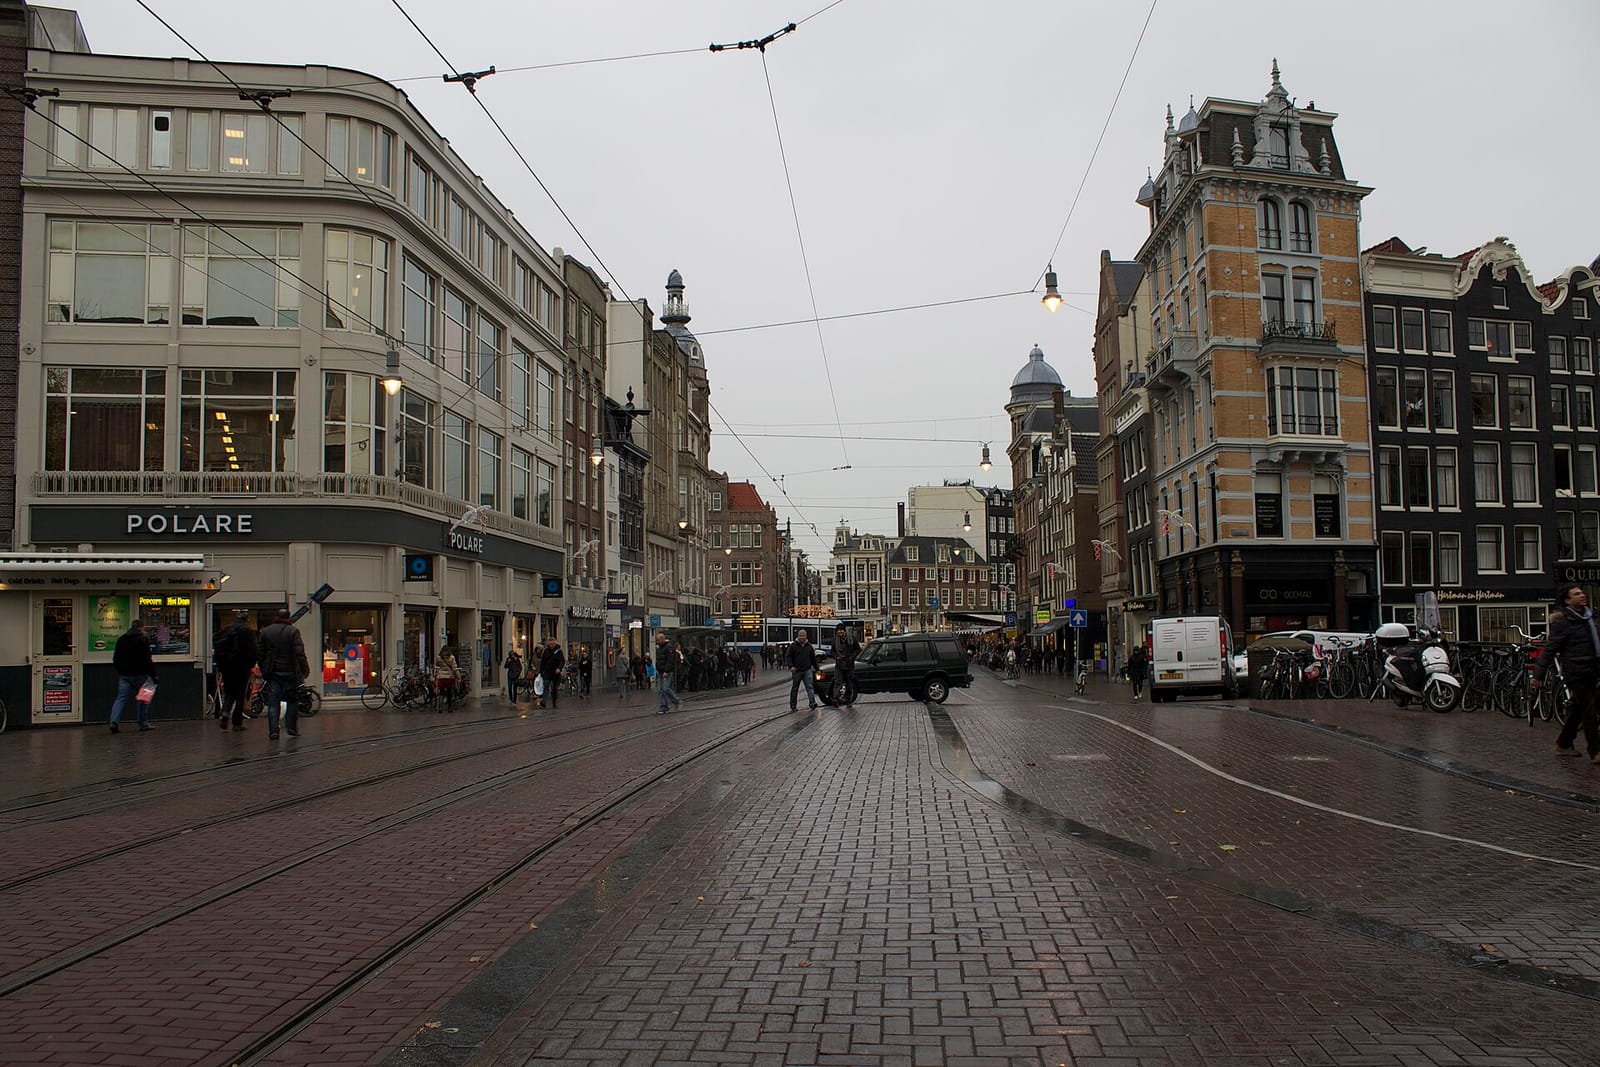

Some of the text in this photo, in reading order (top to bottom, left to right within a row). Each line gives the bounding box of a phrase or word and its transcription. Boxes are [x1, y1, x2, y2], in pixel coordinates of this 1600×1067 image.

[127, 514, 253, 533] POLARE
[451, 533, 484, 553] POLARE
[139, 597, 162, 605] Popcorn
[1437, 590, 1466, 601] Hartman
[1476, 590, 1505, 601] Hartman
[1008, 617, 1014, 625] P
